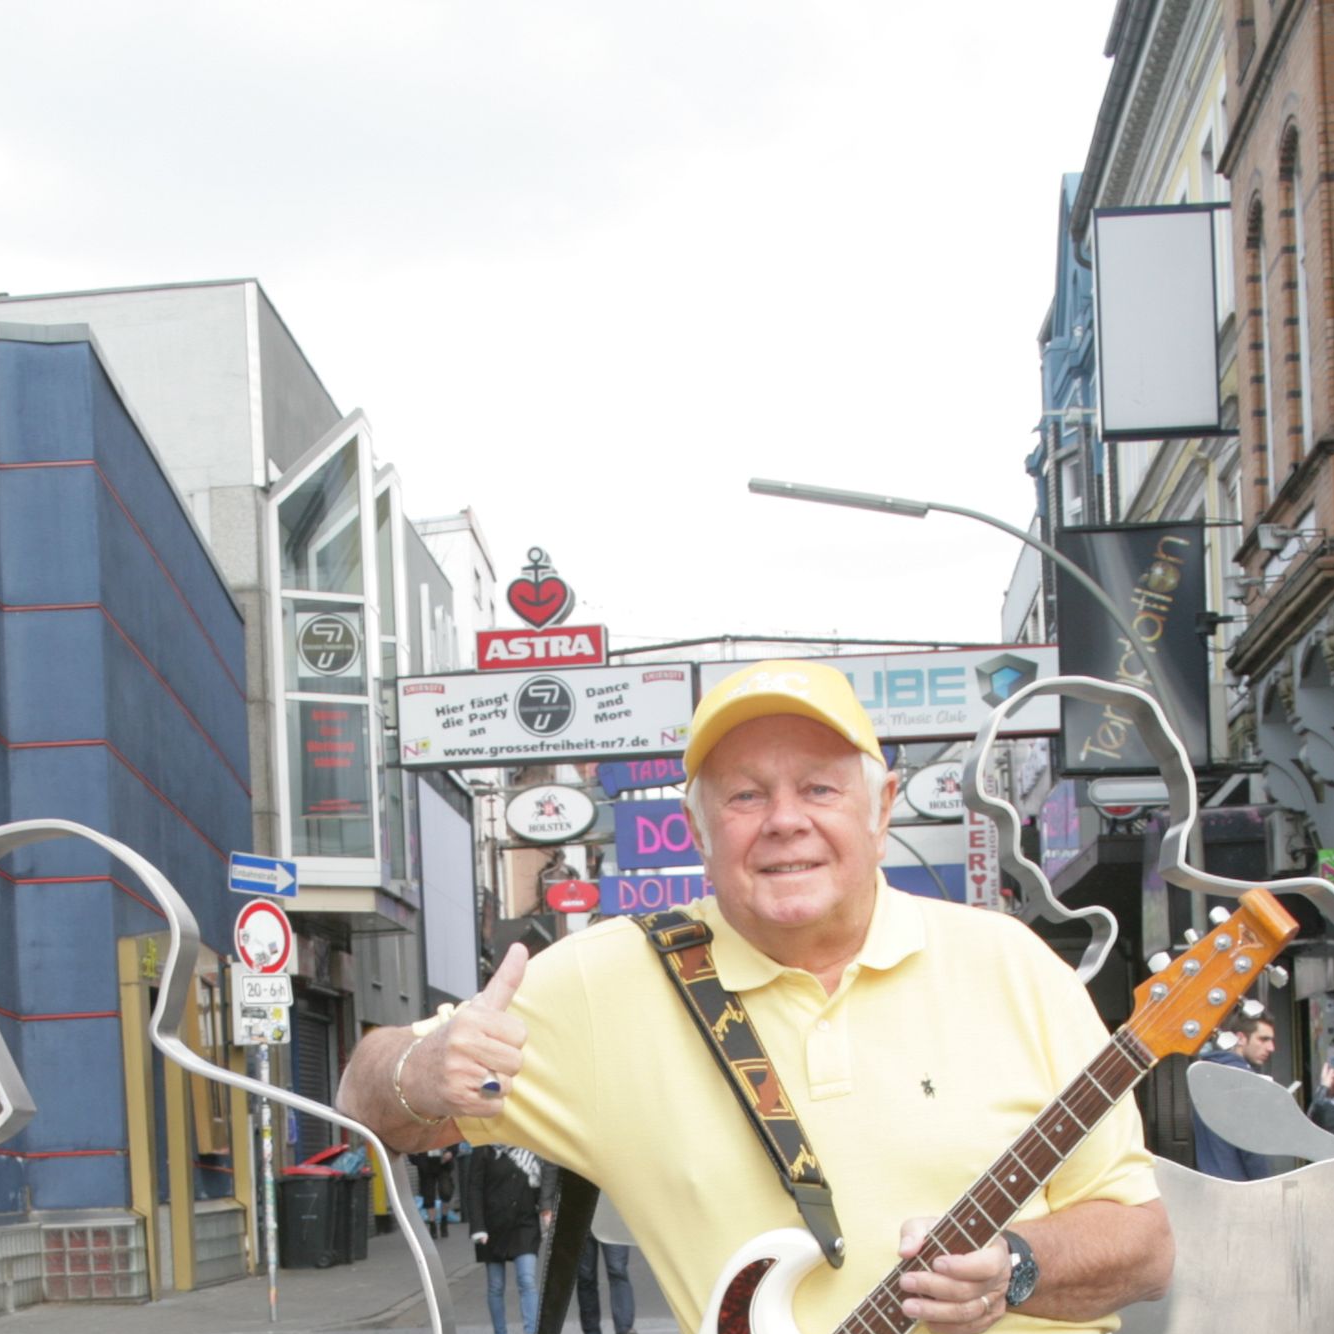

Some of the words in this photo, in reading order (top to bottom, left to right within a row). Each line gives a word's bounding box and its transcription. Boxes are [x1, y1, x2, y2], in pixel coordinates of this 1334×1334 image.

[485, 633, 595, 661] ASTRA
[585, 681, 630, 698] Dance
[435, 703, 465, 718] Hier
[470, 693, 510, 711] fängt
[597, 695, 624, 710] and
[441, 715, 465, 730] die
[469, 707, 509, 725] Party
[594, 707, 632, 724] More
[890, 711, 932, 727] Music
[937, 710, 967, 725] Club
[469, 726, 487, 738] an
[443, 737, 650, 758] www.grossefreiheit-nr7.de
[528, 822, 572, 833] HOLSTEN
[247, 982, 261, 997] 20
